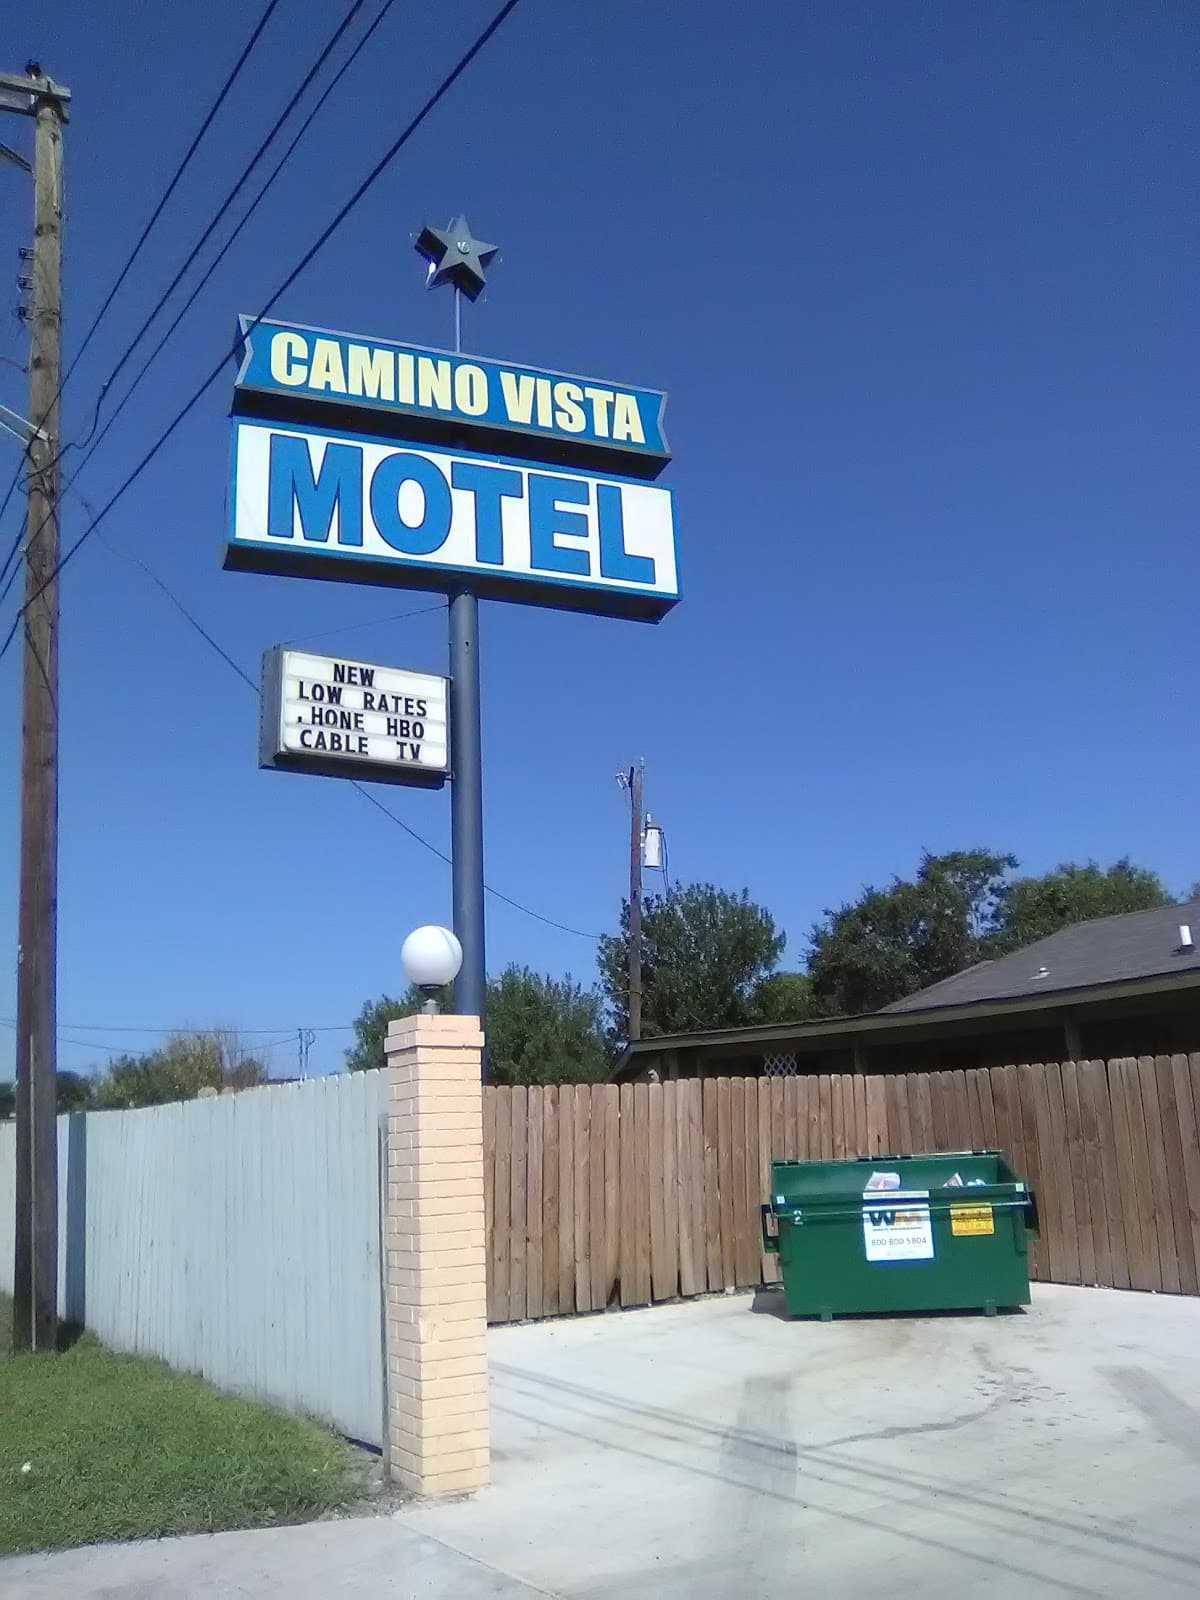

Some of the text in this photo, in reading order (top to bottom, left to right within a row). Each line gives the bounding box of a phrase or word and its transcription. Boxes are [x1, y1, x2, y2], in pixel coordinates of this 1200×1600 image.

[270, 331, 647, 444] CAMINO VISTA
[267, 433, 656, 585] MOTEL
[333, 663, 375, 687] NEW
[299, 681, 427, 718] LOW RATES
[300, 729, 422, 761] CABLE TV
[387, 717, 425, 739] HBO
